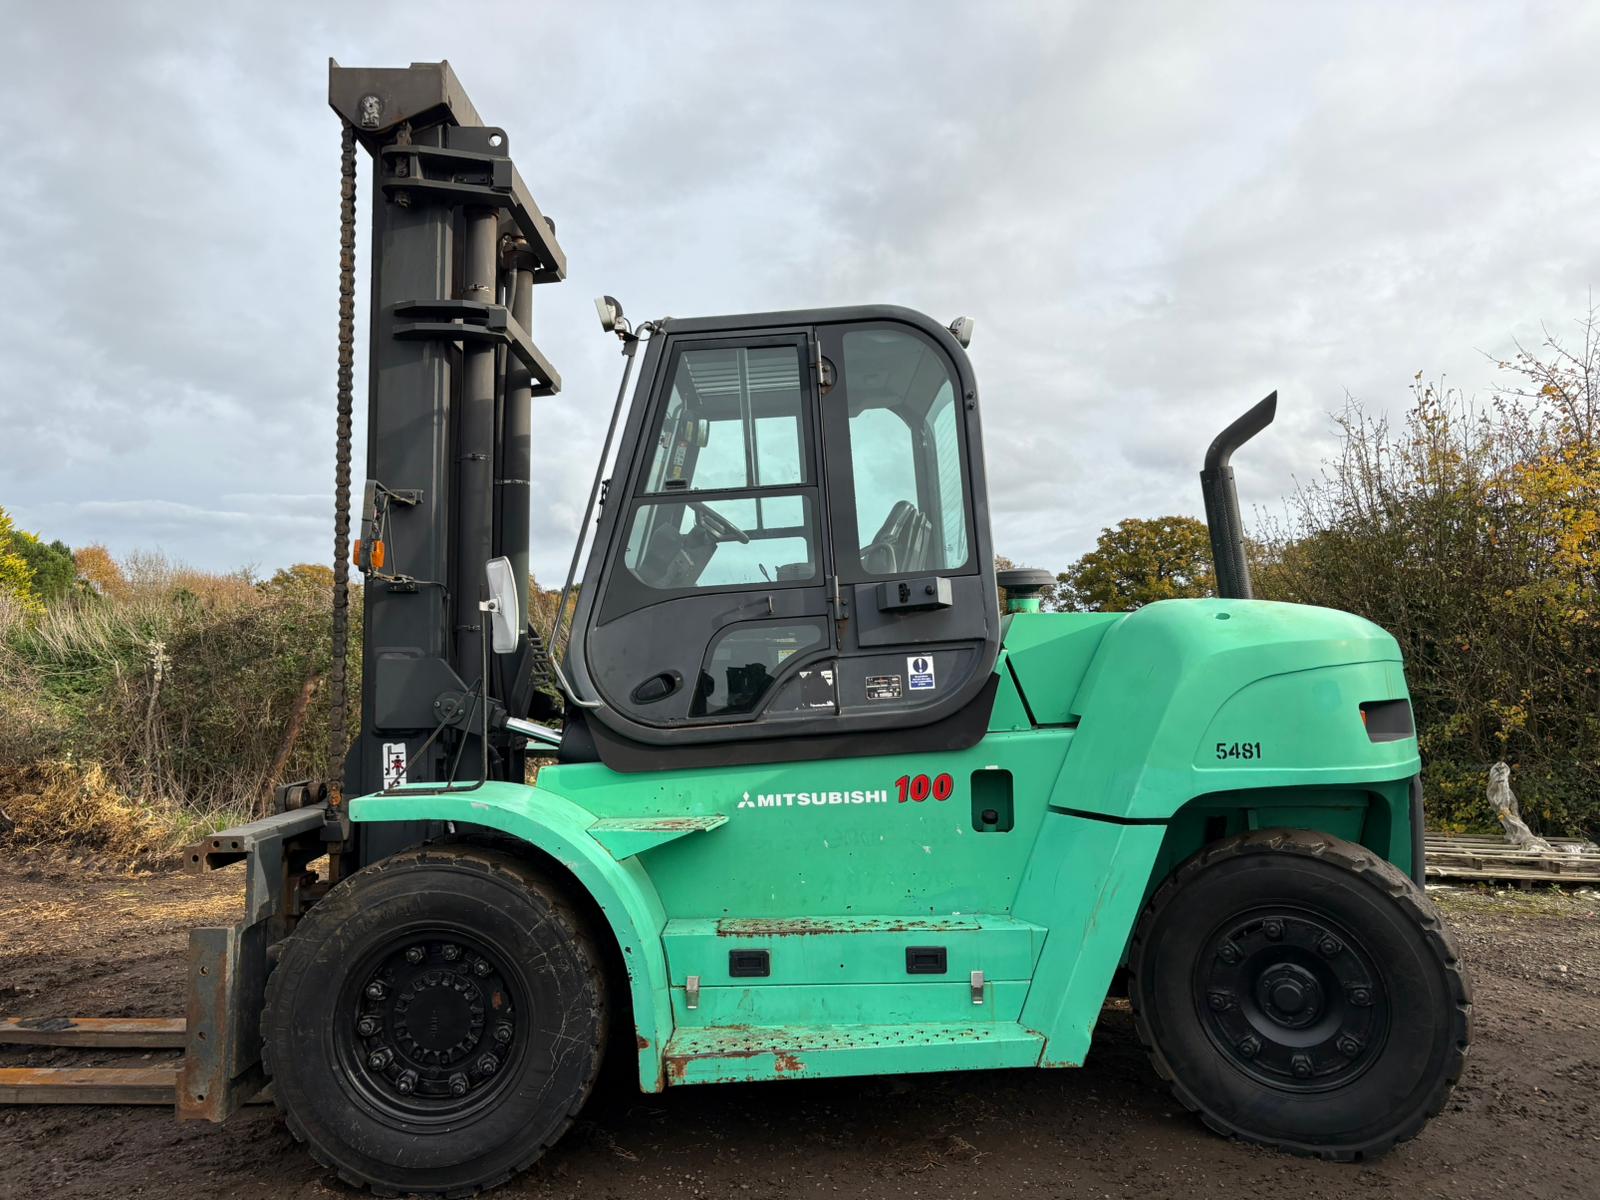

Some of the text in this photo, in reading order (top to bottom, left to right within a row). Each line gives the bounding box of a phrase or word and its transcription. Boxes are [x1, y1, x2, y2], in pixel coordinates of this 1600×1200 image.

[1216, 742, 1261, 760] 5481
[757, 773, 954, 808] MITSUBISHI 100
